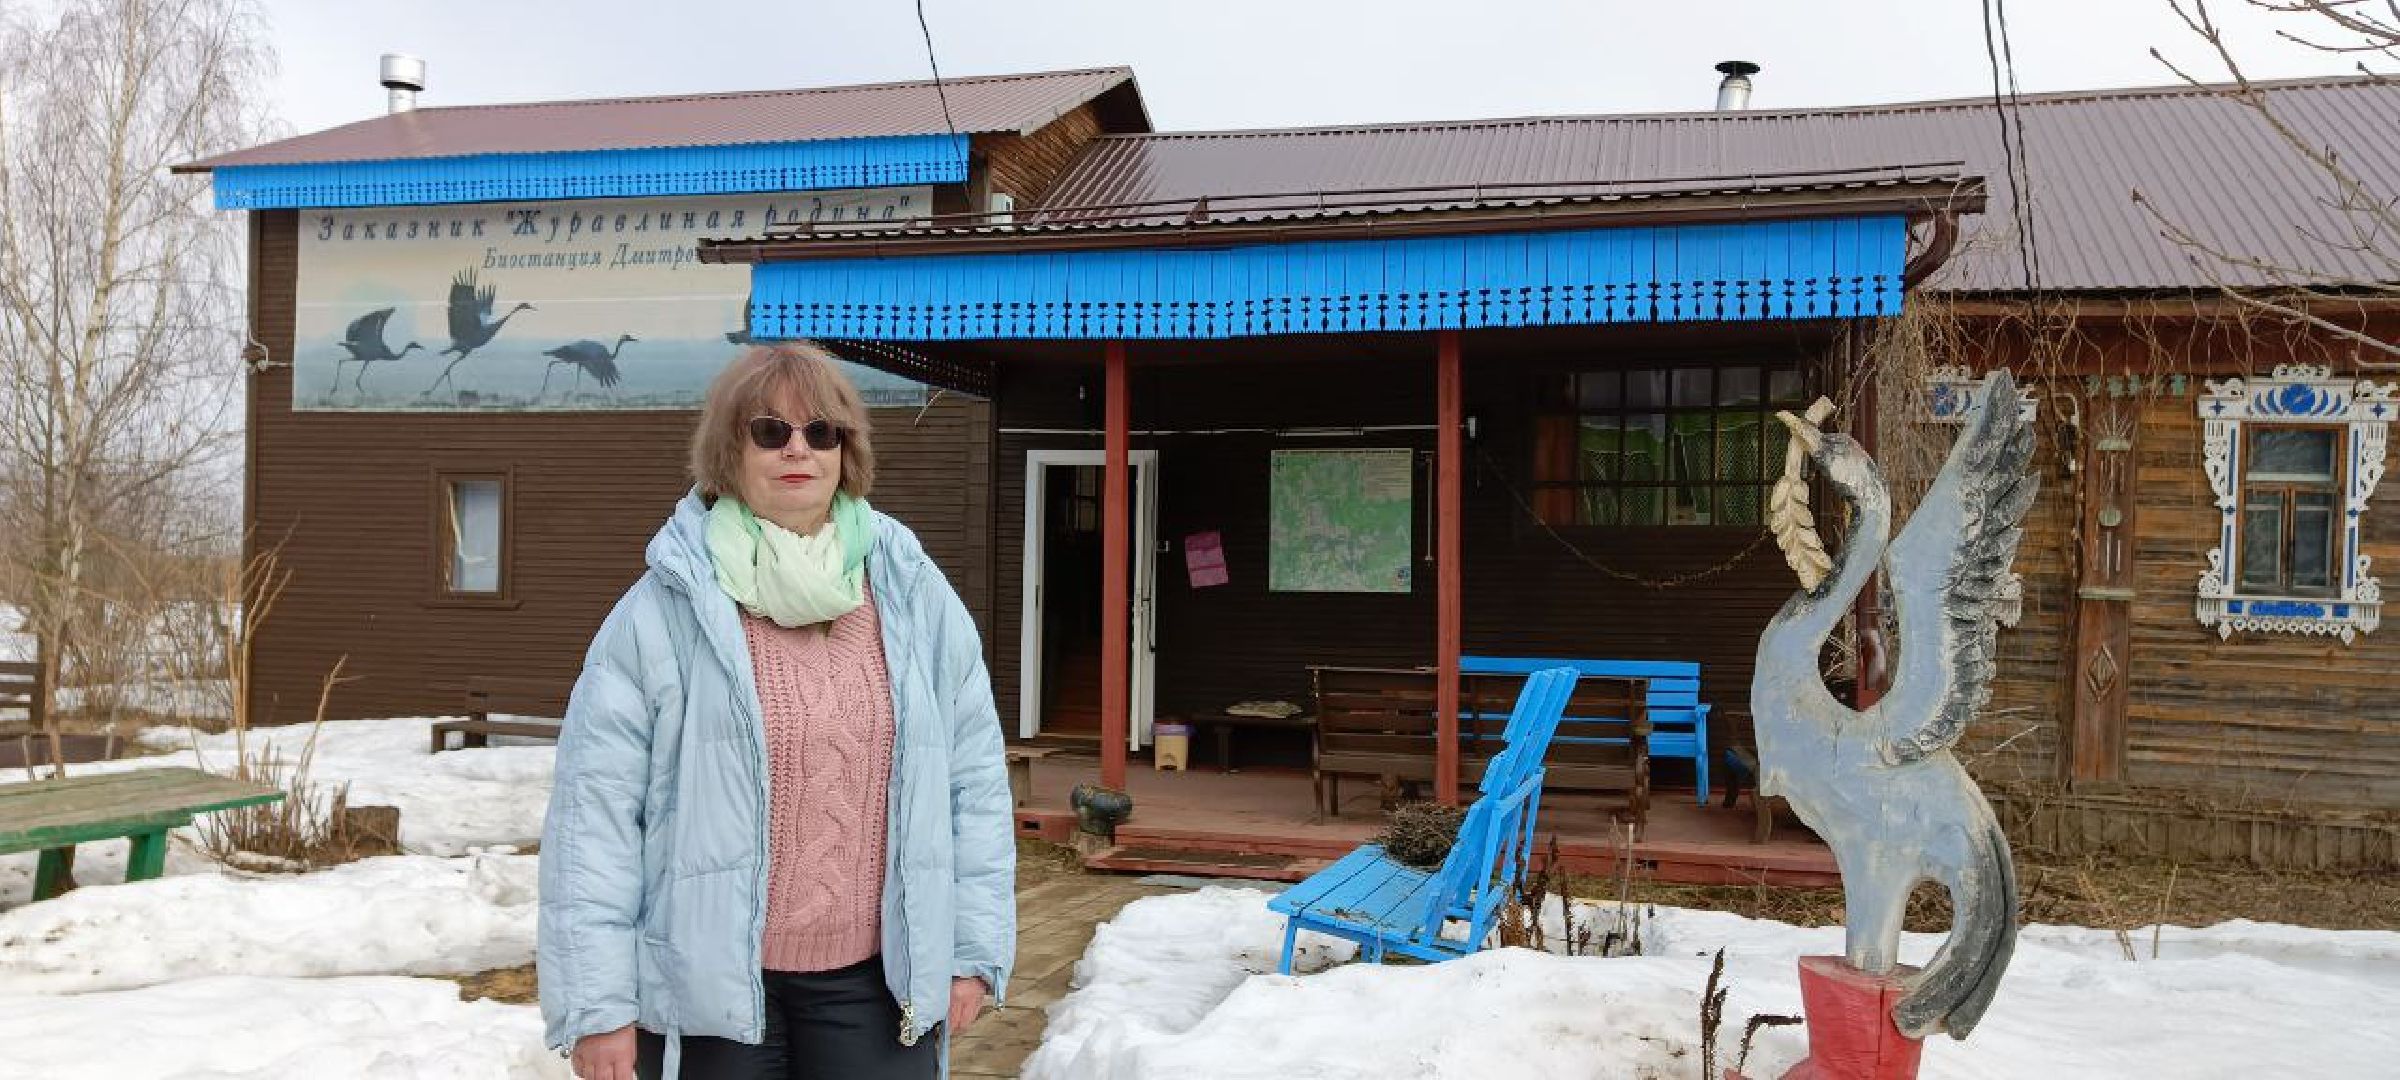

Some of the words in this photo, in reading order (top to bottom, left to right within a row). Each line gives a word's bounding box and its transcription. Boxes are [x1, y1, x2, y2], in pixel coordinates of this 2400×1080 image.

[318, 214, 487, 241] Заказник
[506, 208, 746, 243] "Журавлиная
[482, 246, 601, 270] Биостанция
[610, 242, 696, 271] Дмитро
